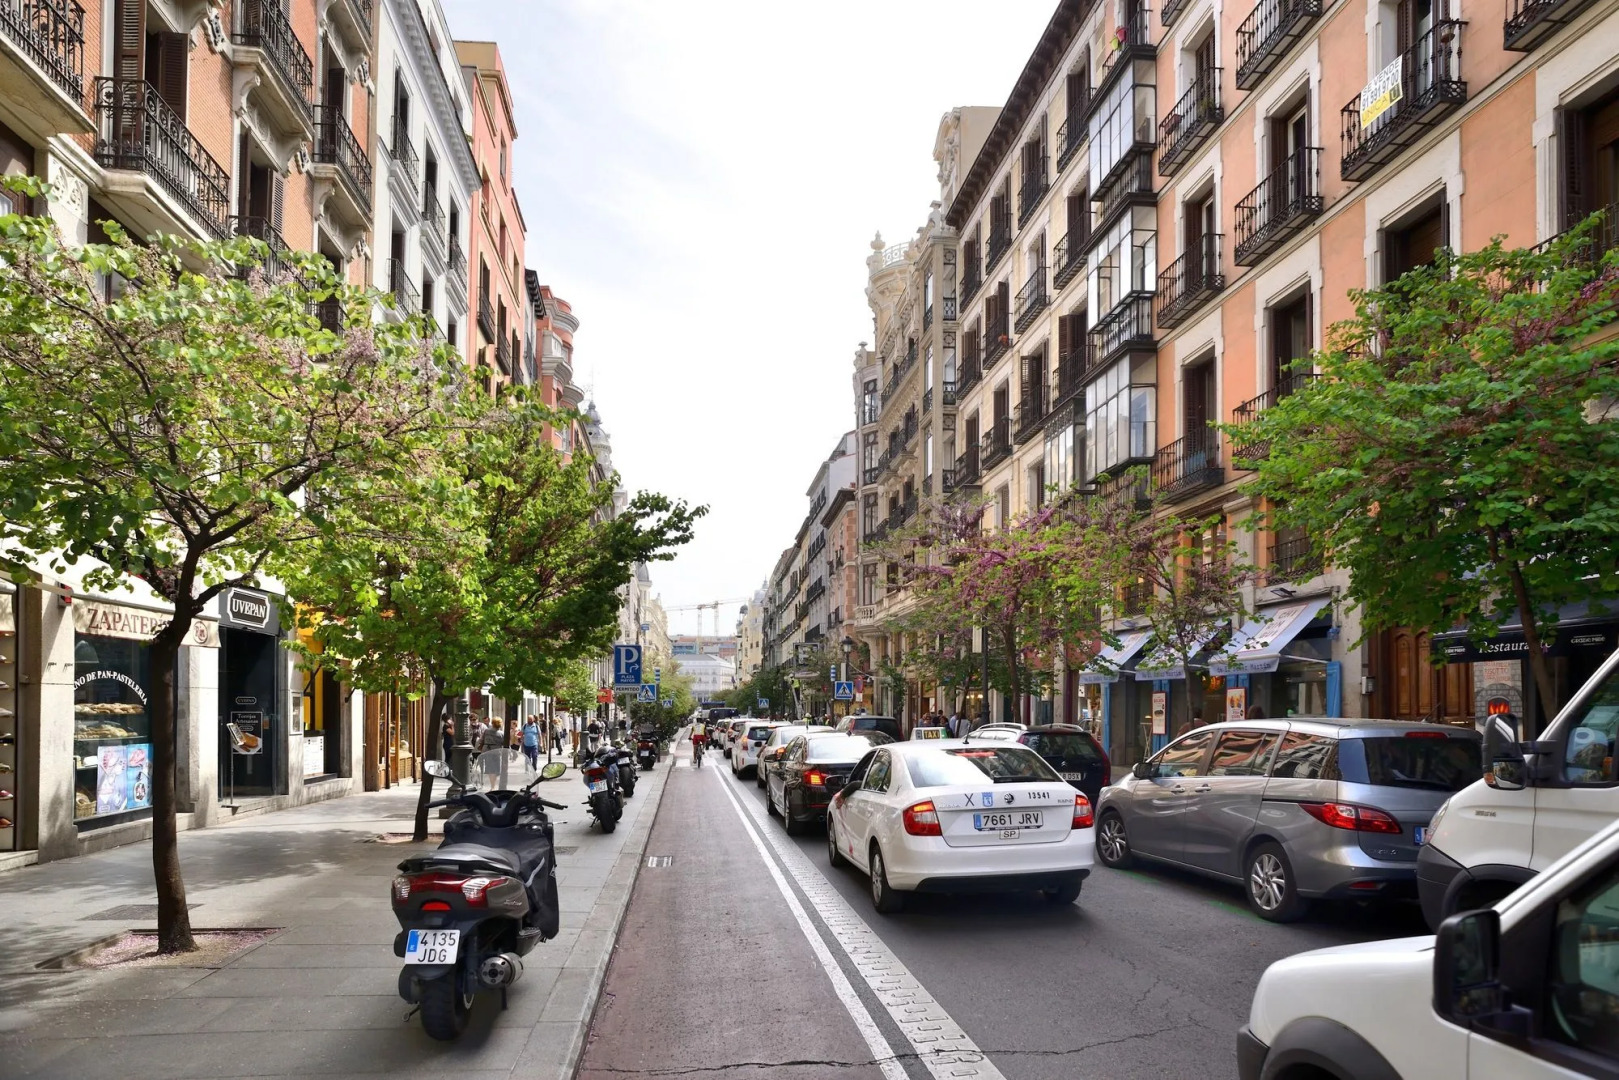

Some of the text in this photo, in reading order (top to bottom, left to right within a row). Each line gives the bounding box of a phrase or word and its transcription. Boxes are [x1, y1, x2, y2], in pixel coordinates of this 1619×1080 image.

[1362, 58, 1400, 97] SE VENDE
[232, 598, 266, 618] UVEPAN
[617, 646, 639, 675] P
[86, 671, 97, 682] DE
[924, 729, 940, 739] TAXI
[964, 793, 975, 807] X
[1028, 791, 1050, 799] 13541
[983, 812, 1039, 826] 7661 JRV
[1003, 830, 1016, 838] SP
[420, 932, 456, 946] 4135
[417, 948, 447, 963] JDG
